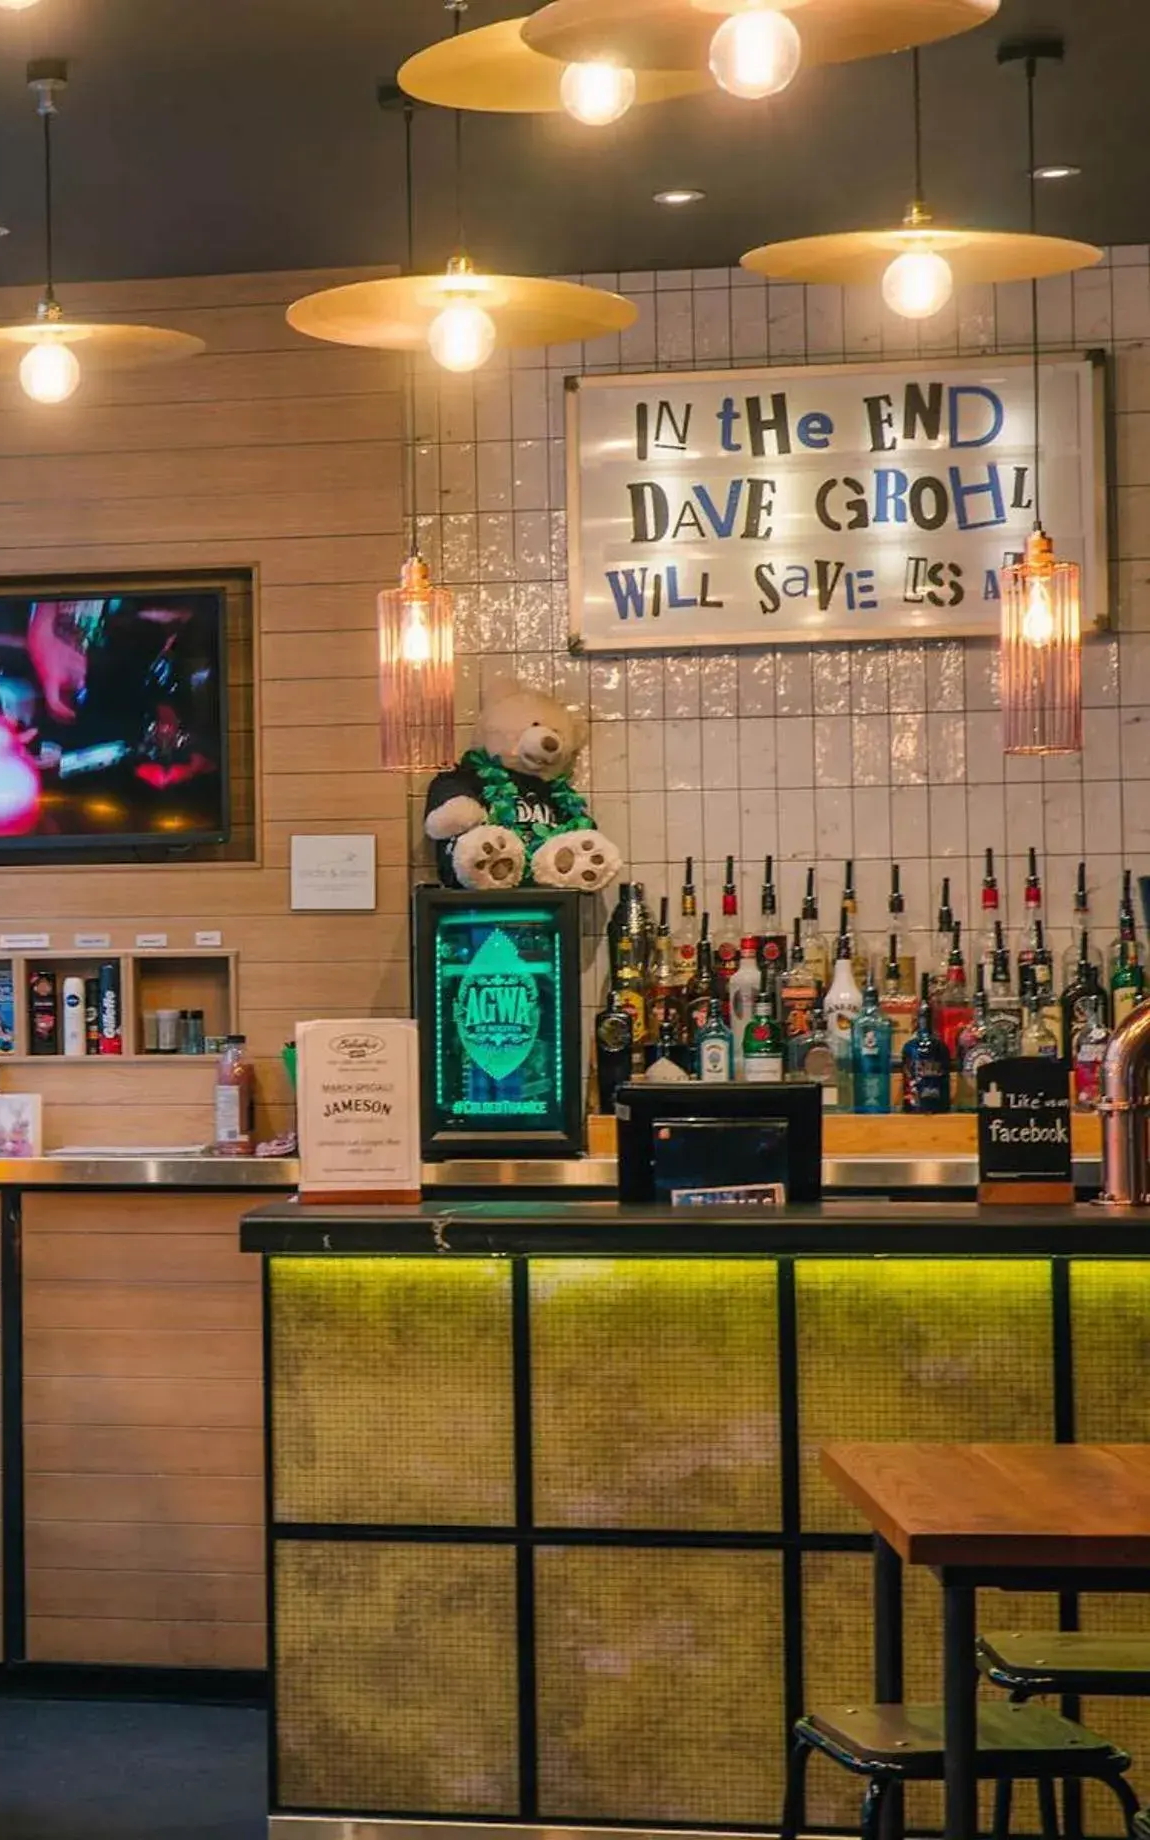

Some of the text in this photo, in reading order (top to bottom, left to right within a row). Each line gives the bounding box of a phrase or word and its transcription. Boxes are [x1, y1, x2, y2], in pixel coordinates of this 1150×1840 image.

[636, 400, 692, 460] IN
[864, 383, 1004, 453] END
[627, 462, 1032, 543] DAVE GROHL
[605, 566, 723, 619] WILL
[465, 985, 531, 1026] AGWA
[323, 1098, 392, 1118] JAMESON
